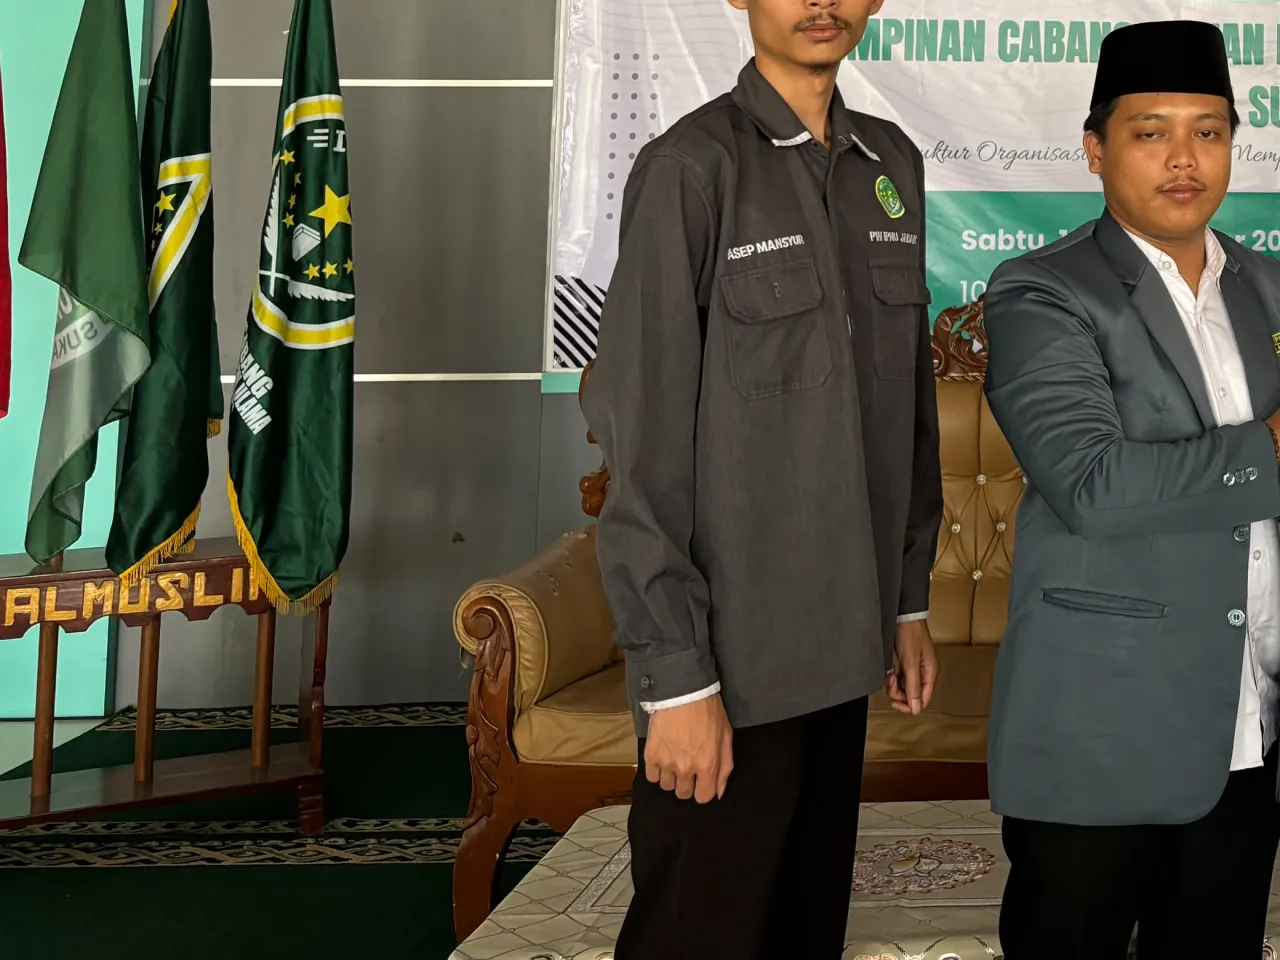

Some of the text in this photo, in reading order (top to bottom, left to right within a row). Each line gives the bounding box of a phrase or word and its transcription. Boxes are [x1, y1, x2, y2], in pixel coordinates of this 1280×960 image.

[848, 18, 986, 61] MPINAN
[997, 19, 1118, 63] CABAN
[727, 234, 804, 260] ASEP MANSYUR
[961, 229, 1044, 251] Sabtu
